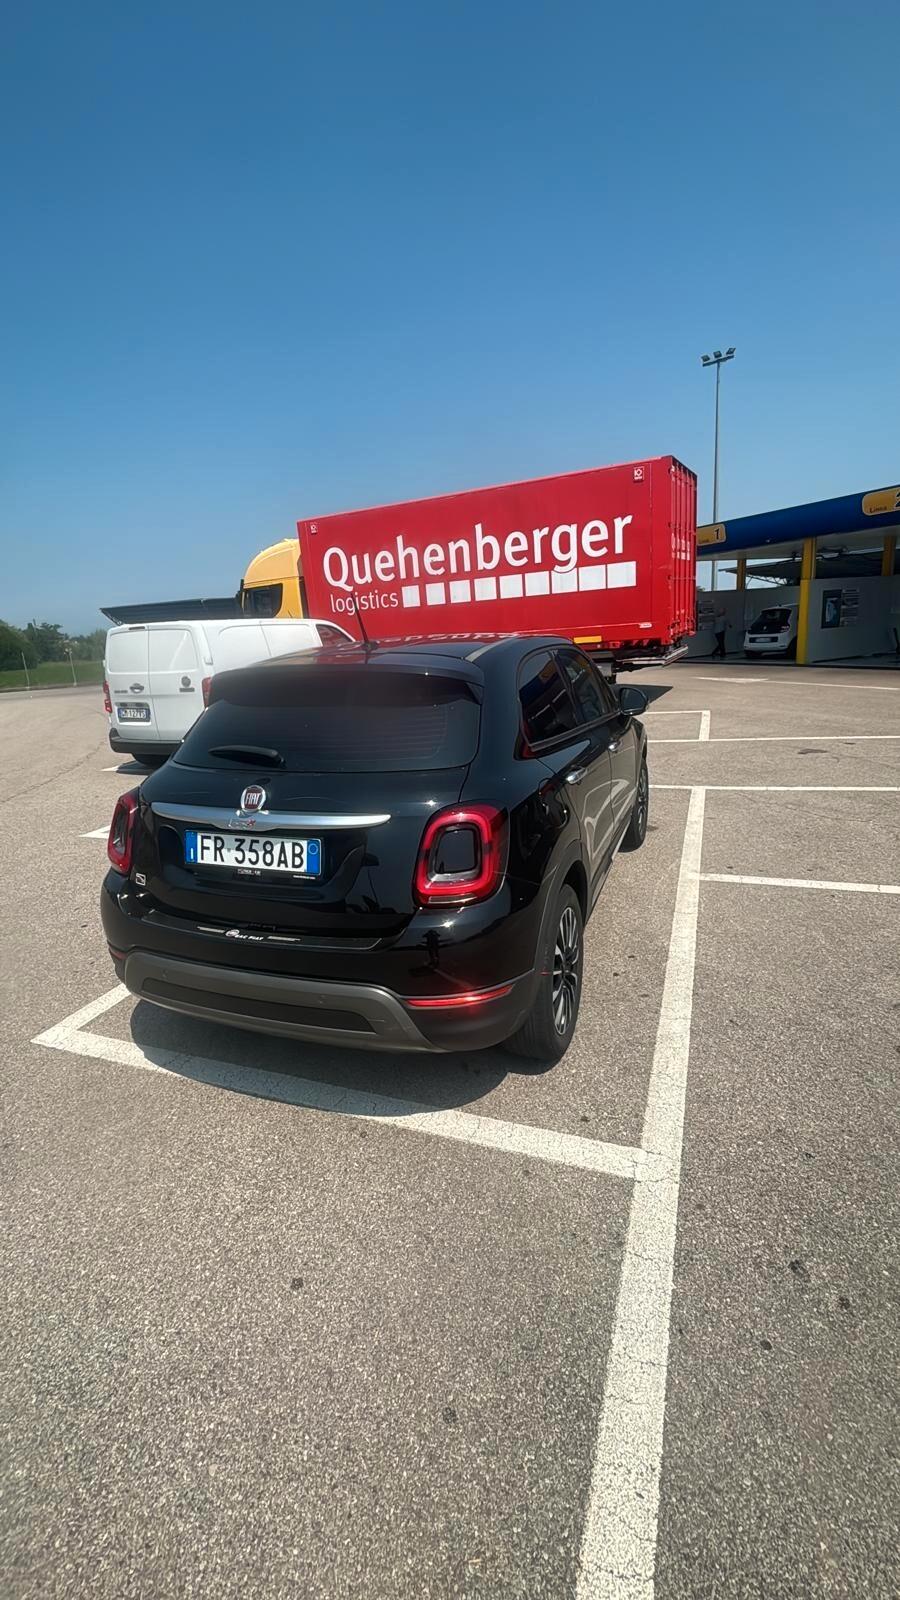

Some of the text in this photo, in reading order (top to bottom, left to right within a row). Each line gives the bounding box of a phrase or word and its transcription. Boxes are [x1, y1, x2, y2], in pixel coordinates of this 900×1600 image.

[714, 527, 720, 540] 1
[323, 514, 632, 591] Quehenberger
[330, 589, 399, 615] logistics
[245, 792, 261, 805] FIAT
[200, 834, 304, 869] FR 358AB
